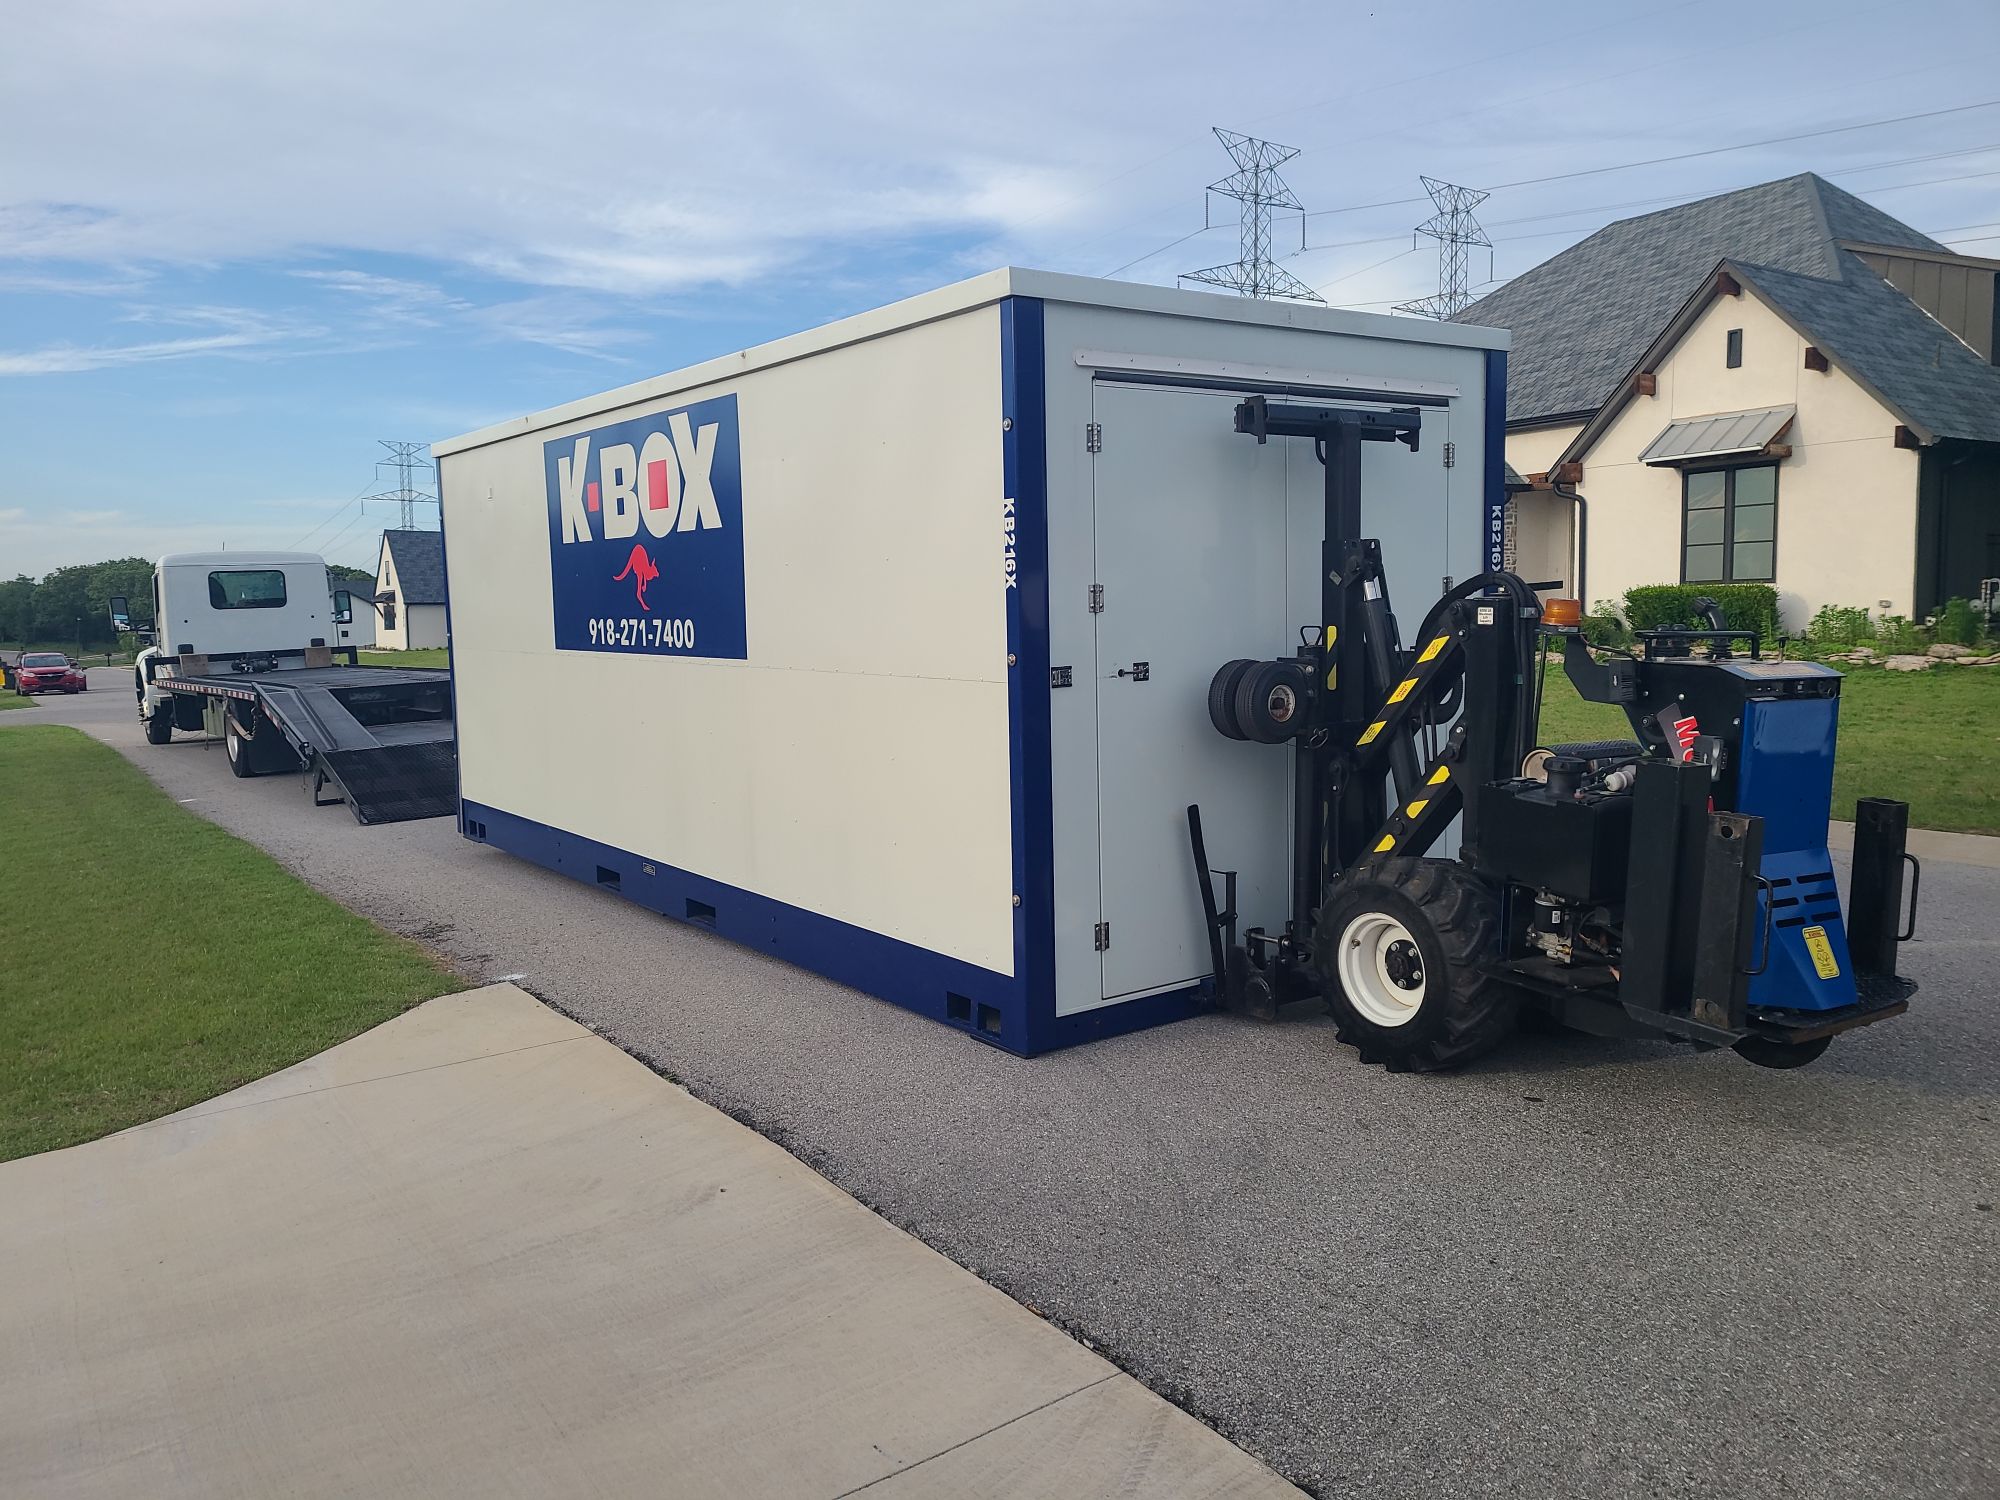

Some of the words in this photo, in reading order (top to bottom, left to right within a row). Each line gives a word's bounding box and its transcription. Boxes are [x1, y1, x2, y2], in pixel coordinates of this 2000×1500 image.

[558, 412, 722, 544] K-BOX
[1003, 498, 1017, 588] KB216X
[589, 618, 695, 648] 918-271-7400
